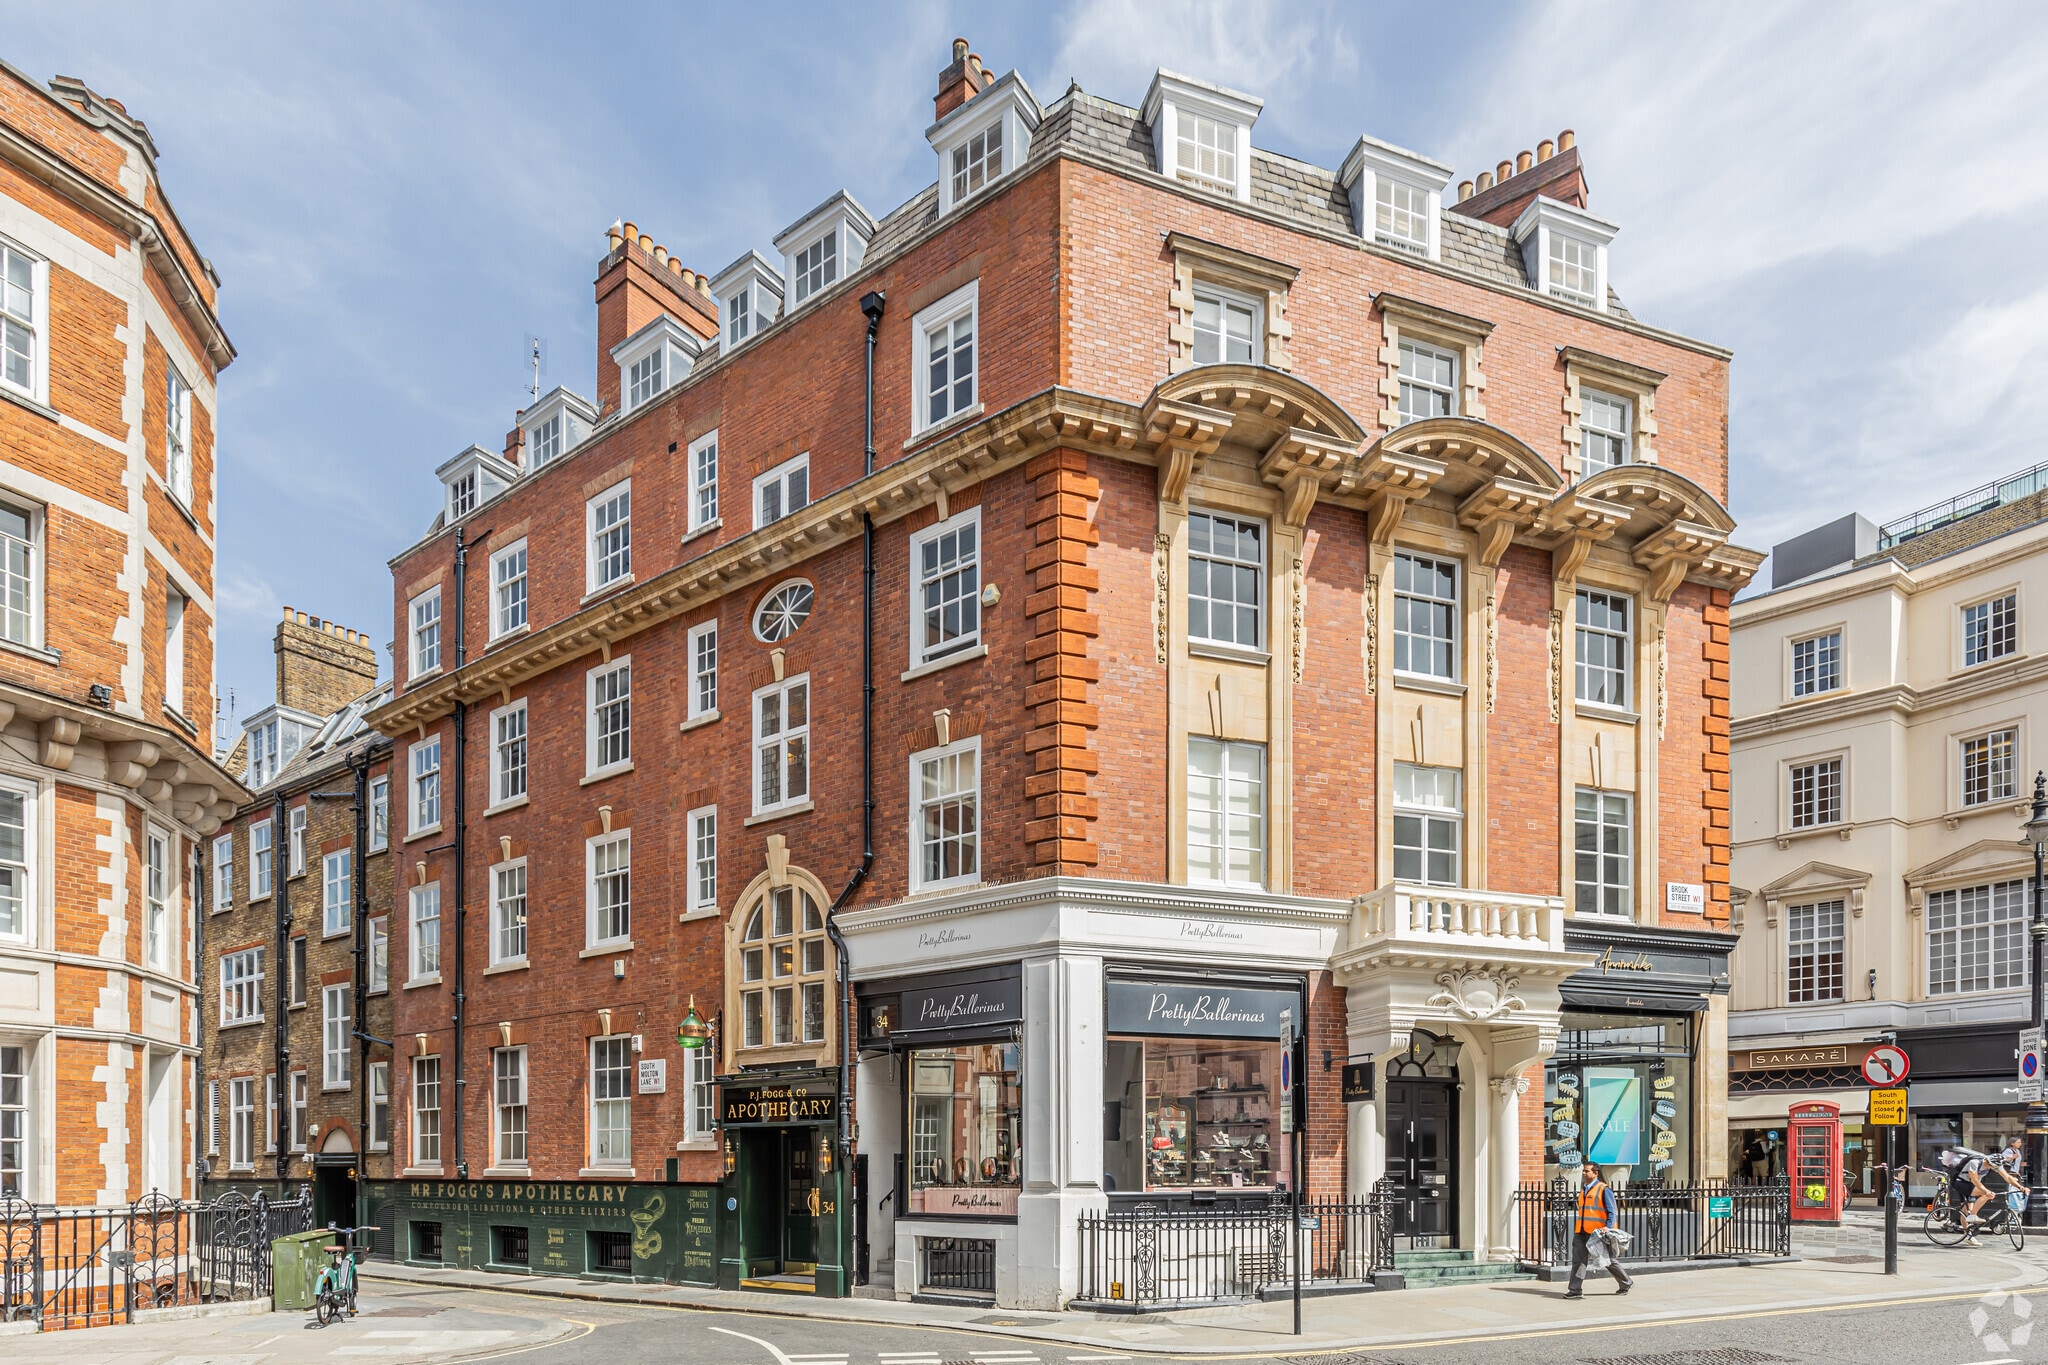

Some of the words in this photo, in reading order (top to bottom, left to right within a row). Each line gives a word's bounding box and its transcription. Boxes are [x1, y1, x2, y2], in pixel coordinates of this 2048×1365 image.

[1671, 885, 1689, 894] BROOK
[1671, 893, 1691, 902] STREET
[1693, 895, 1701, 903] W1
[876, 1015, 889, 1029] 34
[2023, 1044, 2037, 1052] ZONE
[1756, 1050, 1840, 1064] SAKARÉ
[641, 1062, 655, 1070] SOUTH
[641, 1070, 658, 1078] MOLTON
[640, 1078, 652, 1086] LANE
[787, 1089, 793, 1097] &
[728, 1100, 831, 1119] APOTHECARY
[1599, 1120, 1631, 1132] SALE
[411, 1184, 430, 1197] MR
[438, 1184, 494, 1198] FOGG'S
[502, 1185, 628, 1202] APOTHECARY
[411, 1202, 468, 1211] COMPOUNDED
[474, 1204, 524, 1213] LIBATIONS
[540, 1206, 574, 1215] OTHER
[581, 1207, 626, 1217] ELIXIRS
[822, 1201, 835, 1214] 34
